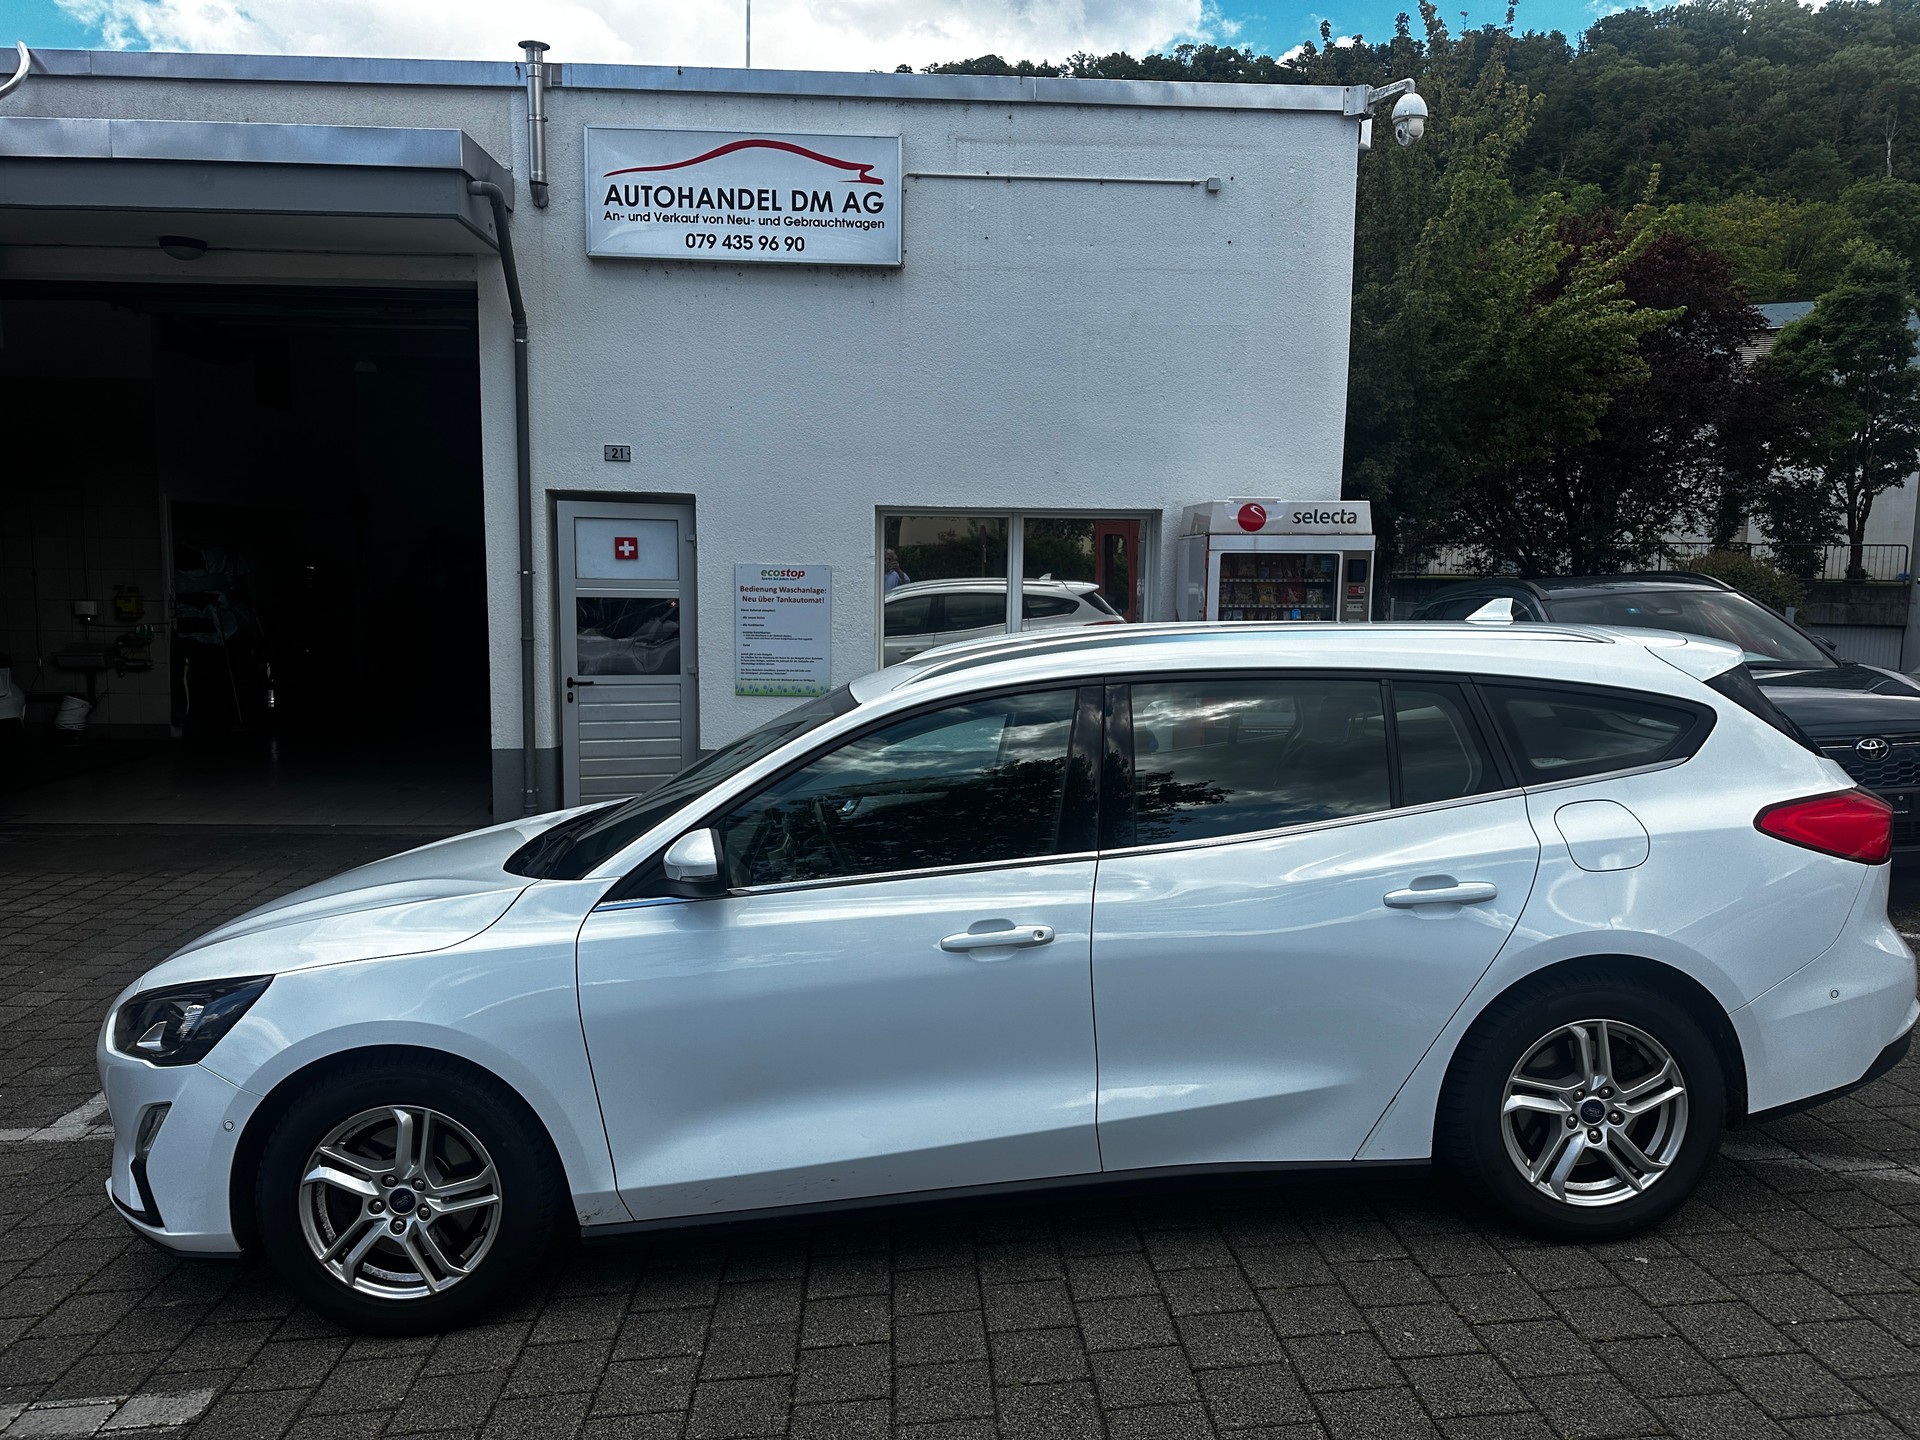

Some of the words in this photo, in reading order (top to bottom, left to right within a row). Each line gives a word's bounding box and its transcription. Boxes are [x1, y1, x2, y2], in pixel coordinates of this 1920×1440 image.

[603, 184, 782, 212] AUTOHANDEL
[791, 190, 834, 213] DM
[841, 191, 884, 214] AG
[603, 211, 625, 222] An-
[628, 211, 650, 222] und
[653, 212, 699, 225] Verkauf
[702, 215, 723, 225] von
[727, 214, 755, 226] Neu-
[758, 215, 780, 227] und
[783, 216, 885, 231] Gebrauchtwagen
[685, 233, 717, 250] 079
[721, 234, 753, 250] 435
[758, 235, 779, 251] 96
[783, 236, 805, 252] 90
[611, 447, 624, 459] 21
[1291, 508, 1357, 525] selecta
[760, 569, 806, 579] ecostop
[740, 585, 777, 594] Bedienung
[779, 586, 827, 595] Waschanlage:
[742, 595, 757, 603] Neu
[758, 595, 774, 603] über
[776, 596, 825, 604] Tankautomat!
